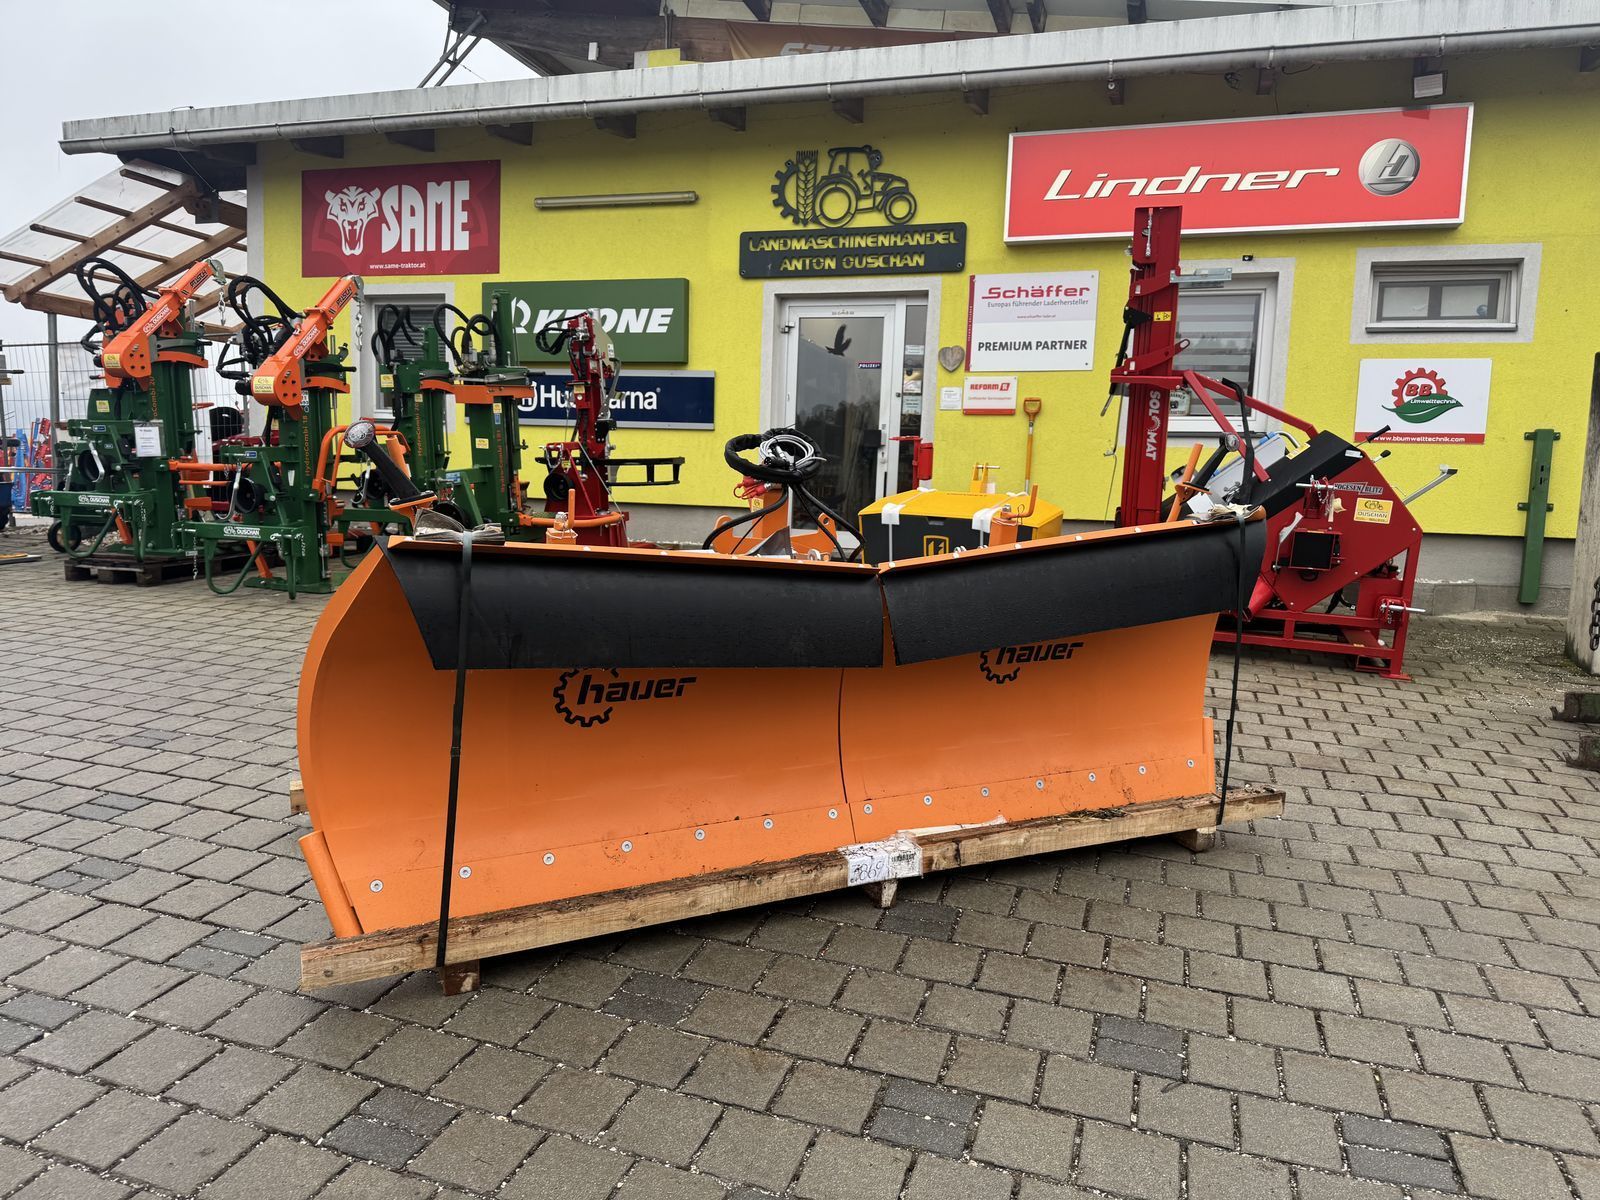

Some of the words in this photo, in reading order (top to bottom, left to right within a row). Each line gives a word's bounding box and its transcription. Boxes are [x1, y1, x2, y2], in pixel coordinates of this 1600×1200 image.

[1043, 166, 1341, 201] Lindner
[381, 180, 470, 254] SAME
[749, 229, 959, 252] LANDMASCHINENHANDEL
[369, 262, 426, 270] www.same-traktor.at
[780, 256, 837, 272] ANTON
[842, 253, 926, 269] OUSCHAN
[981, 284, 1090, 300] Schäffer
[987, 301, 1011, 309] Europas
[1043, 298, 1089, 307] Laderhersteller
[533, 307, 675, 334] KONE
[977, 341, 1033, 352] PREMIUM
[1035, 339, 1088, 351] PARTNER
[969, 383, 999, 391] REFORM
[1404, 383, 1433, 397] BB
[577, 674, 698, 705] hauer
